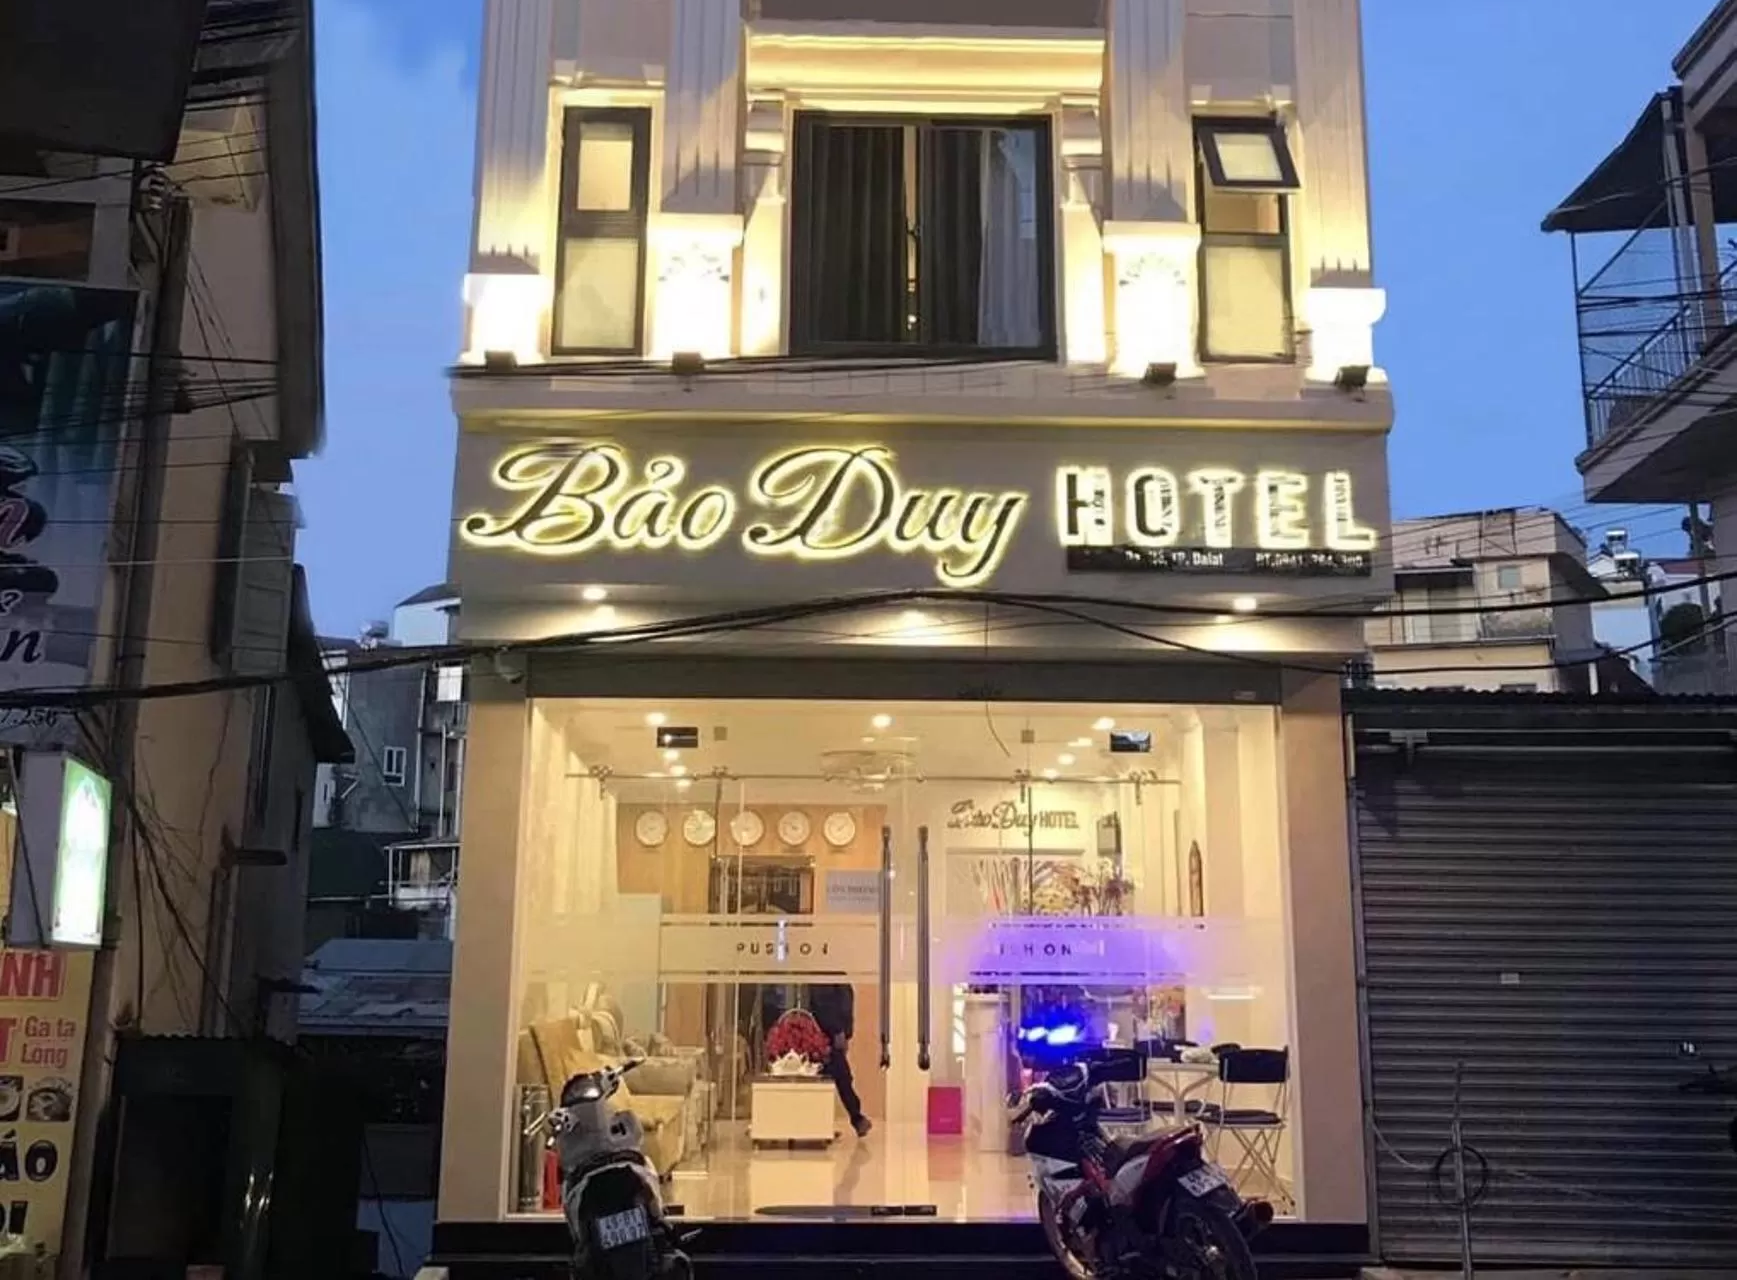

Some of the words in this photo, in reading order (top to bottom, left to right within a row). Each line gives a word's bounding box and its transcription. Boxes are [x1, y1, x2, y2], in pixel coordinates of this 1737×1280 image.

[464, 443, 736, 557] Bảo
[744, 445, 1028, 586] Duy
[1056, 464, 1379, 549] HOTEL
[1039, 810, 1080, 829] HOTEL
